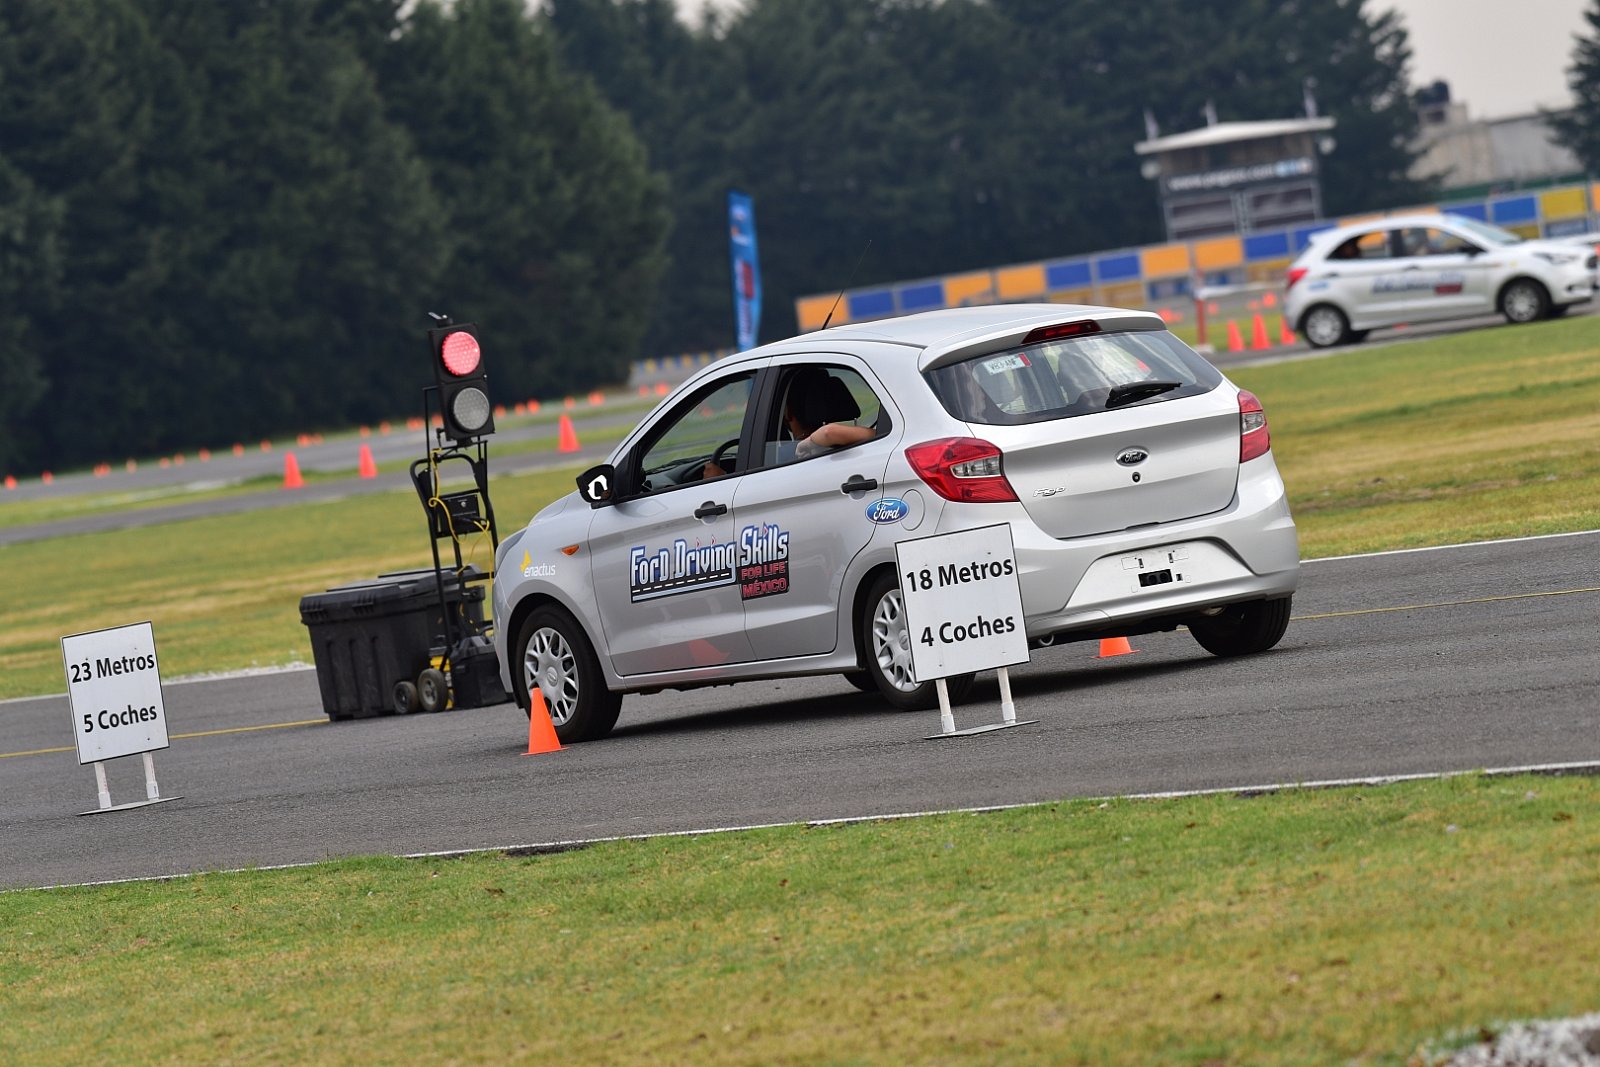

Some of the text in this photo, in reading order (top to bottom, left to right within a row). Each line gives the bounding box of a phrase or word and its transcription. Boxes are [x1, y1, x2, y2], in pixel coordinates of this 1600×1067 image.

[1123, 451, 1143, 463] Ford
[873, 501, 900, 520] Ford
[674, 537, 737, 584] Driving
[740, 523, 789, 567] Skills
[523, 562, 556, 578] enactus
[741, 562, 785, 580] FOR LIFE
[906, 558, 1013, 592] 18 Metros
[743, 577, 787, 598] MÉXICO
[920, 615, 1015, 647] 4 Coches
[70, 654, 155, 683] 23 Metros
[83, 704, 157, 733] 5 Coches
